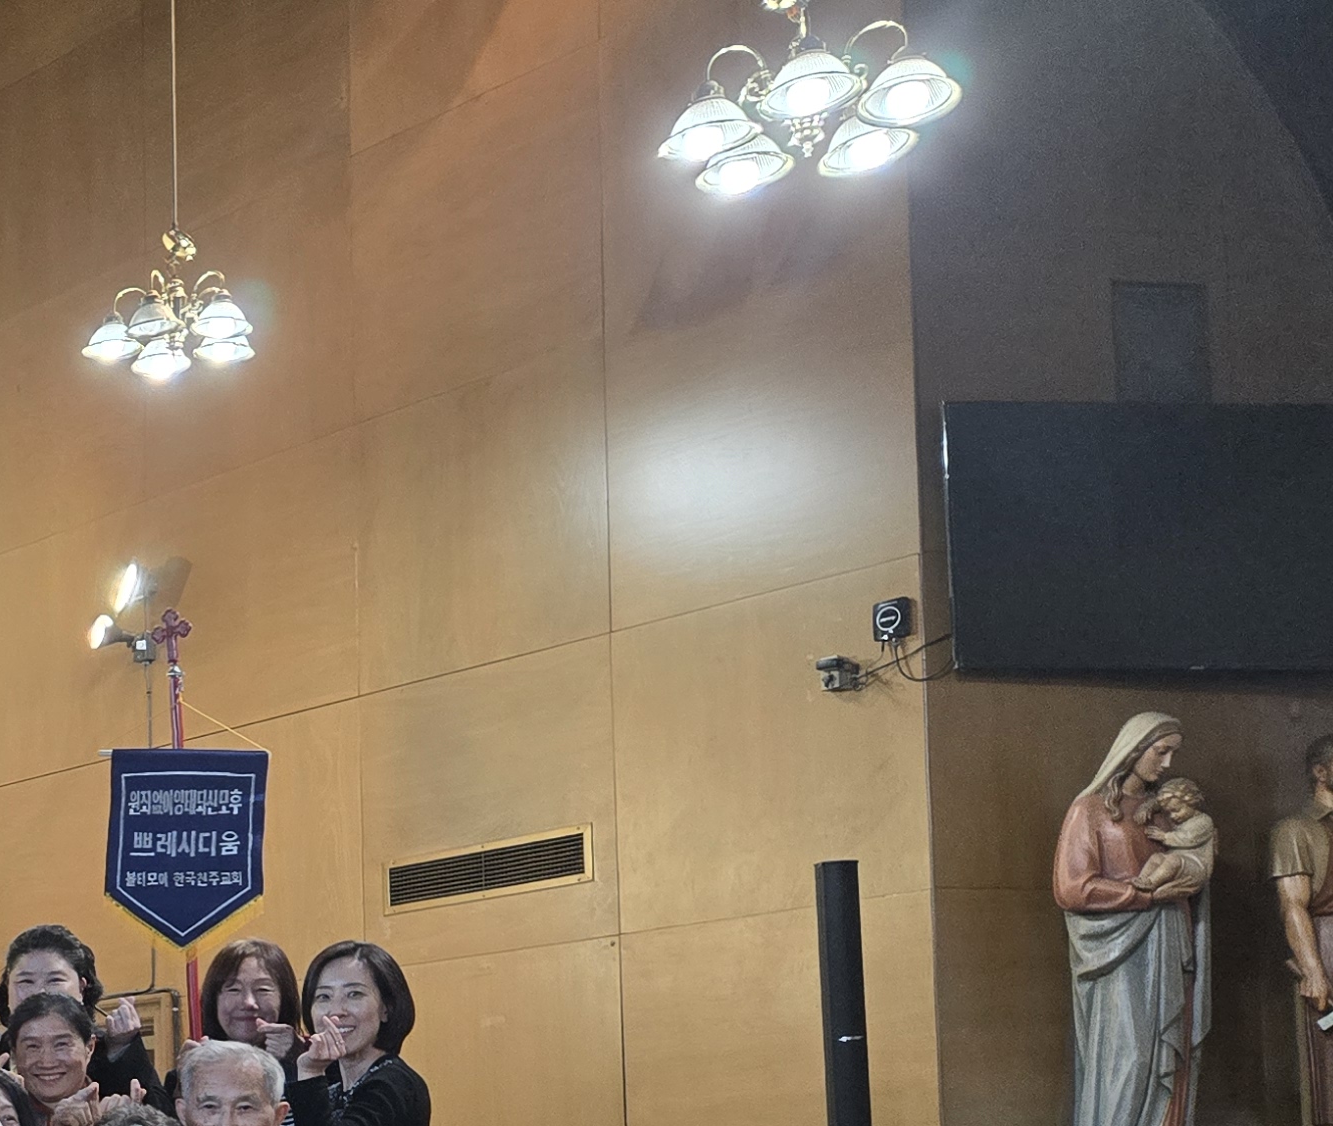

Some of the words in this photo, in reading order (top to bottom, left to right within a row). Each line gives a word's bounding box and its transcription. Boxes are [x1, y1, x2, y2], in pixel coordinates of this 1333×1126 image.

[130, 831, 240, 857] 쁘레시디움
[125, 871, 169, 887] 볼티모어
[173, 871, 243, 887] 한국천주교회
